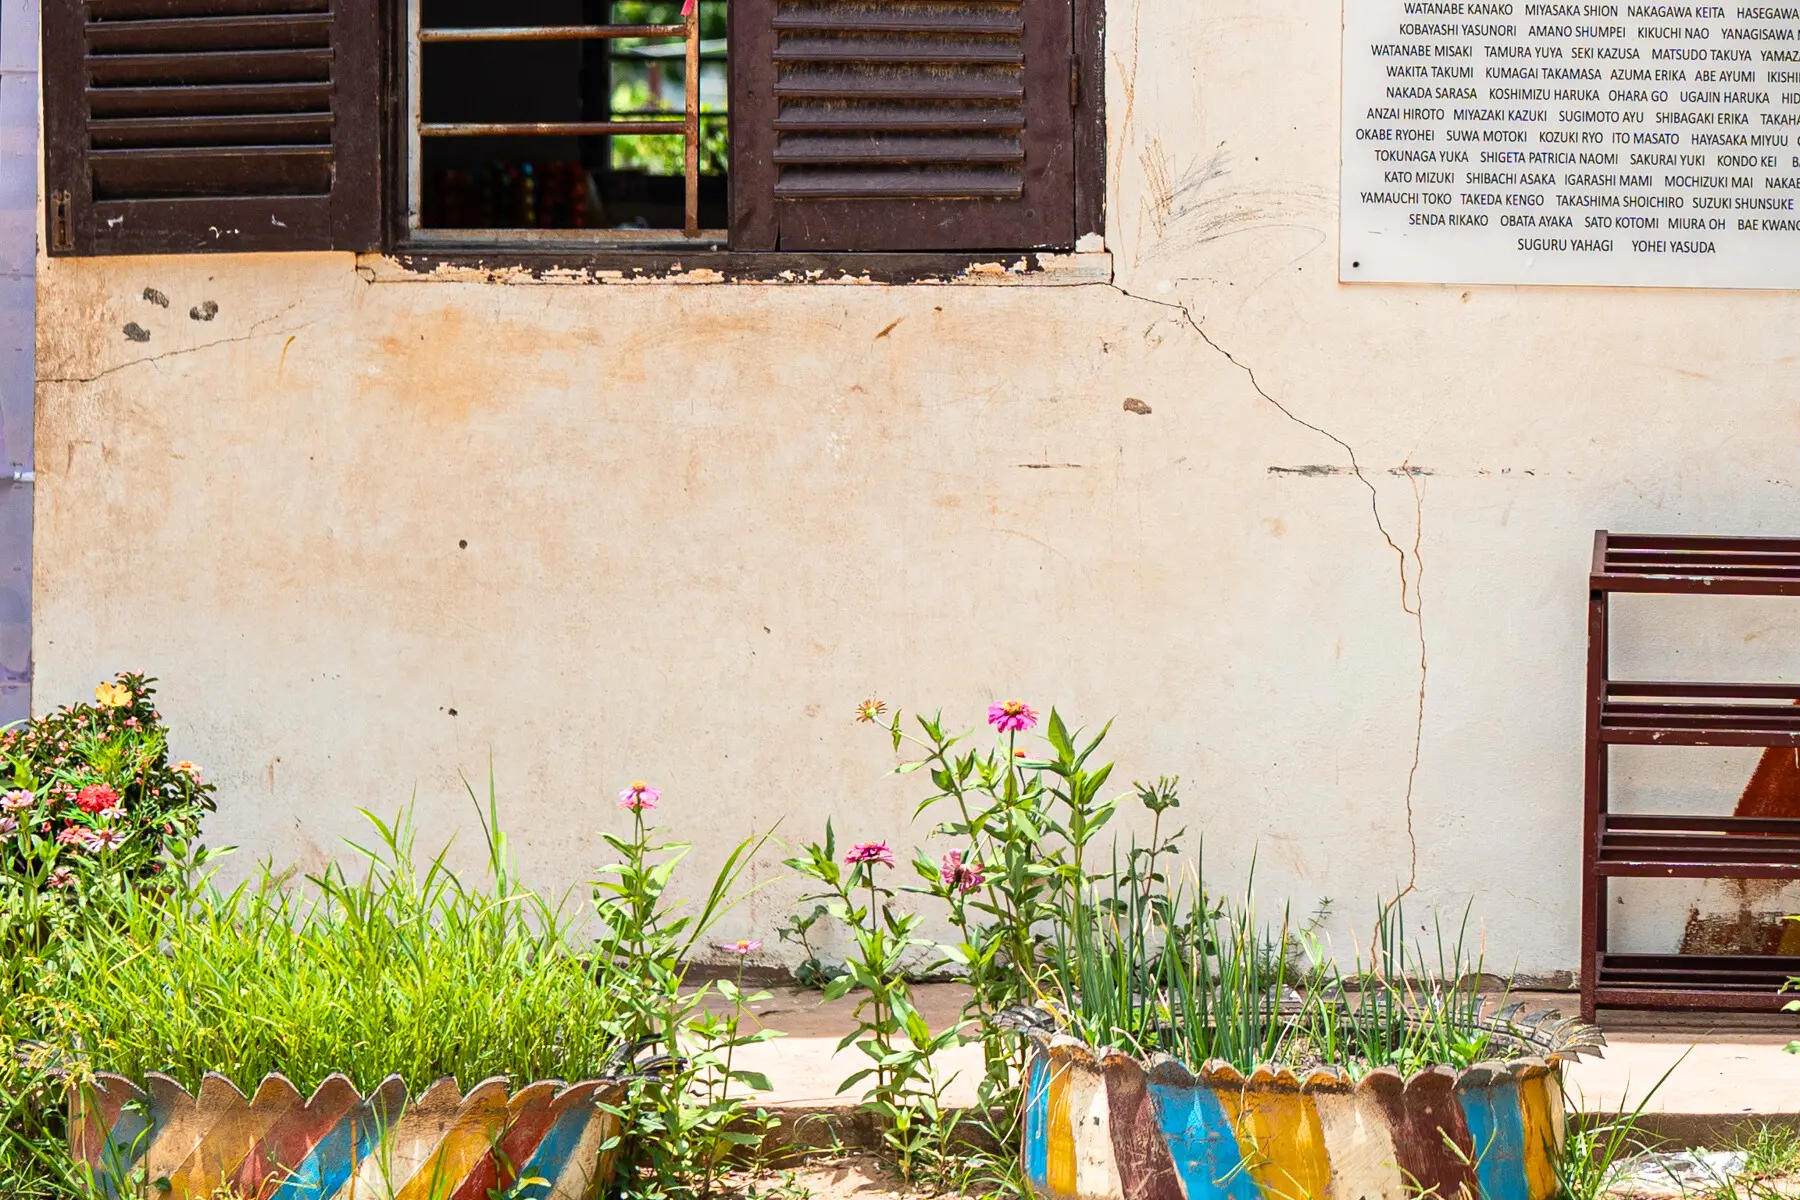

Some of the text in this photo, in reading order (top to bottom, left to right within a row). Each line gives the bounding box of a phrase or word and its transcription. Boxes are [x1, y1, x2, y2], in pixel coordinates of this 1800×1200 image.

[1404, 2, 1464, 15] WATANABE
[1467, 2, 1513, 16] KANAKO
[1525, 3, 1581, 17] MIYASAKA
[1583, 4, 1618, 17] SHION
[1627, 5, 1692, 18] NAKAGAWA
[1695, 6, 1725, 19] KEITA
[1737, 6, 1800, 20] HASEGAWA
[1400, 22, 1458, 36] KOBAYASHI
[1461, 24, 1516, 37] YASUNORI
[1528, 24, 1572, 38] AMANO
[1574, 25, 1626, 38] SHUMPEI
[1638, 26, 1681, 39] KIKUCHI
[1685, 27, 1710, 40] NAO
[1721, 27, 1794, 41] YANAGISAWA
[1371, 43, 1433, 57] WATANABE
[1434, 44, 1472, 58] MISAKI
[1484, 45, 1532, 58] TAMURA
[1534, 46, 1563, 59] YUYA
[1571, 46, 1596, 59] SEKI
[1597, 47, 1640, 60] KAZUSA
[1652, 47, 1708, 61] MATSUDO
[1710, 48, 1752, 62] TAKUYA
[1386, 65, 1428, 78] WAKITA
[1430, 65, 1473, 79] TAKUMI
[1486, 66, 1538, 79] KUMAGAI
[1541, 67, 1602, 80] TAKAMASA
[1610, 68, 1652, 81] AZUMA
[1655, 67, 1686, 82] ERIKA
[1694, 69, 1716, 82] ABE
[1719, 70, 1755, 83] AYUMI
[1386, 86, 1432, 99] NAKADA
[1435, 86, 1478, 100] SARASA
[1489, 87, 1552, 101] KOSHIMIZU
[1554, 88, 1600, 101] HARUKA
[1608, 89, 1648, 102] OHARA
[1651, 90, 1668, 102] GO
[1680, 90, 1720, 103] UGAJIN
[1724, 91, 1770, 104] HARUKA
[1366, 107, 1400, 120] ANZAI
[1403, 107, 1444, 121] HIROTO
[1453, 108, 1504, 121] MIYAZAKI
[1508, 109, 1547, 122] KAZUKI
[1558, 110, 1620, 123] SUGIMOTO
[1622, 111, 1644, 124] AYU
[1656, 111, 1714, 124] SHIBAGAKI
[1717, 112, 1749, 125] ERIKA
[1356, 128, 1392, 141] OKABE
[1395, 128, 1434, 141] RYOHEI
[1446, 129, 1480, 142] SUWA
[1483, 129, 1527, 143] MOTOKI
[1539, 130, 1581, 144] KOZUKI
[1582, 131, 1604, 144] RYO
[1612, 132, 1630, 144] ITO
[1633, 132, 1679, 145] MASATO
[1691, 133, 1748, 146] HAYASAKA
[1751, 134, 1789, 147] MIYUU
[1374, 149, 1436, 162] TOKUNAGA
[1439, 150, 1469, 163] YUKA
[1480, 150, 1526, 164] SHIGETA
[1529, 151, 1576, 164] PATRICIA
[1579, 152, 1618, 165] NAOMI
[1630, 153, 1677, 166] SAKURAI
[1680, 154, 1705, 166] YUKI
[1717, 154, 1758, 167] KONDO
[1761, 155, 1777, 168] KEI
[1384, 170, 1412, 183] KATO
[1415, 171, 1454, 184] MIZUKI
[1466, 172, 1516, 185] SHIBACHI
[1519, 172, 1556, 185] ASAKA
[1565, 173, 1616, 186] IGARASHI
[1619, 174, 1652, 187] MAMI
[1665, 175, 1728, 188] MOCHIZUKI
[1731, 176, 1753, 188] MAI
[1360, 191, 1419, 204] YAMAUCHI
[1421, 192, 1452, 205] TOKO
[1460, 192, 1503, 206] TAKEDA
[1505, 193, 1544, 206] KENGO
[1556, 194, 1620, 208] TAKASHIMA
[1623, 195, 1684, 209] SHOICHIRO
[1692, 196, 1732, 209] SUZUKI
[1735, 197, 1794, 210] SHUNSUKE
[1408, 213, 1447, 226] SENDA
[1449, 213, 1489, 227] RIKAKO
[1500, 214, 1536, 227] OBATA
[1538, 215, 1573, 228] AYAKA
[1584, 215, 1612, 228] SATO
[1615, 216, 1659, 229] KOTOMI
[1668, 217, 1706, 230] MIURA
[1708, 218, 1725, 230] OH
[1738, 218, 1759, 231] BAE
[1517, 237, 1716, 254] SUGURU YAHAGI YOHEI YASUDA
